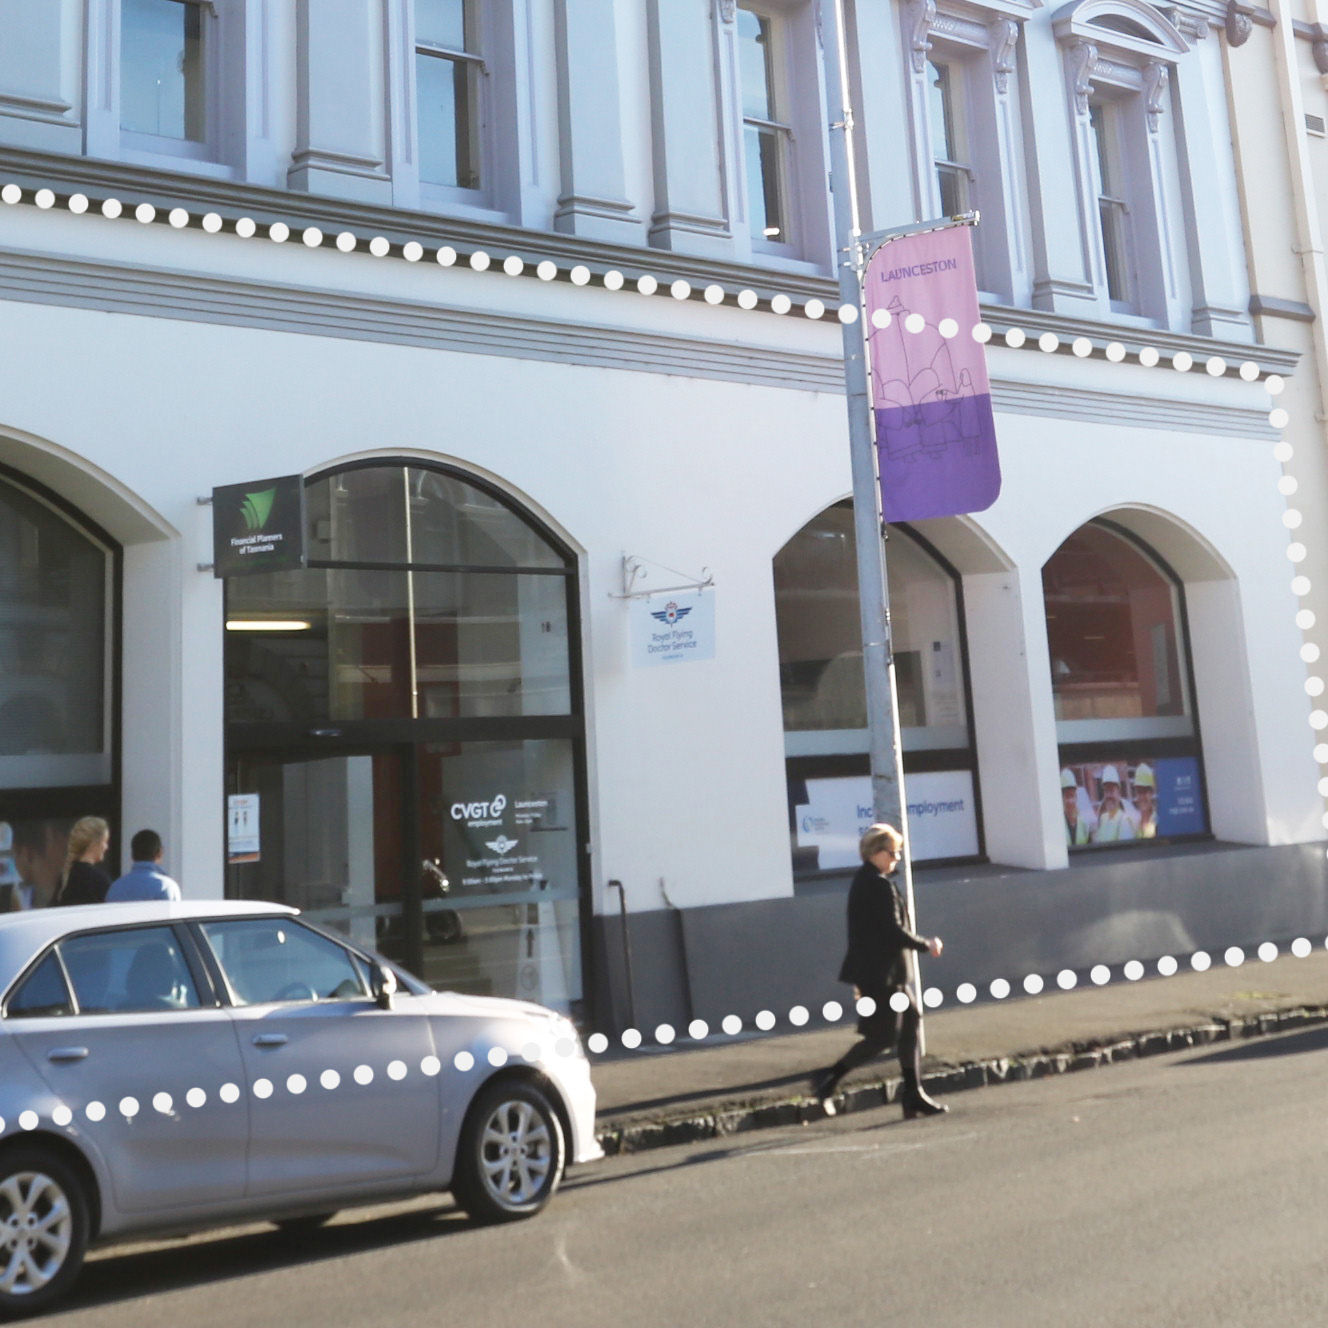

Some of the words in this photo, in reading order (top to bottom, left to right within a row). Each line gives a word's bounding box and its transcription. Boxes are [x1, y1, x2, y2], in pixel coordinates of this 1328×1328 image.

[880, 258, 957, 283] LAUNCESTON
[230, 536, 256, 546] Financial
[257, 533, 283, 543] Planners
[652, 632, 670, 643] Royal
[672, 630, 693, 640] Flying
[647, 644, 671, 654] Doctor
[672, 640, 697, 651] Service
[451, 802, 489, 819] CVGT
[907, 799, 965, 816] mployment
